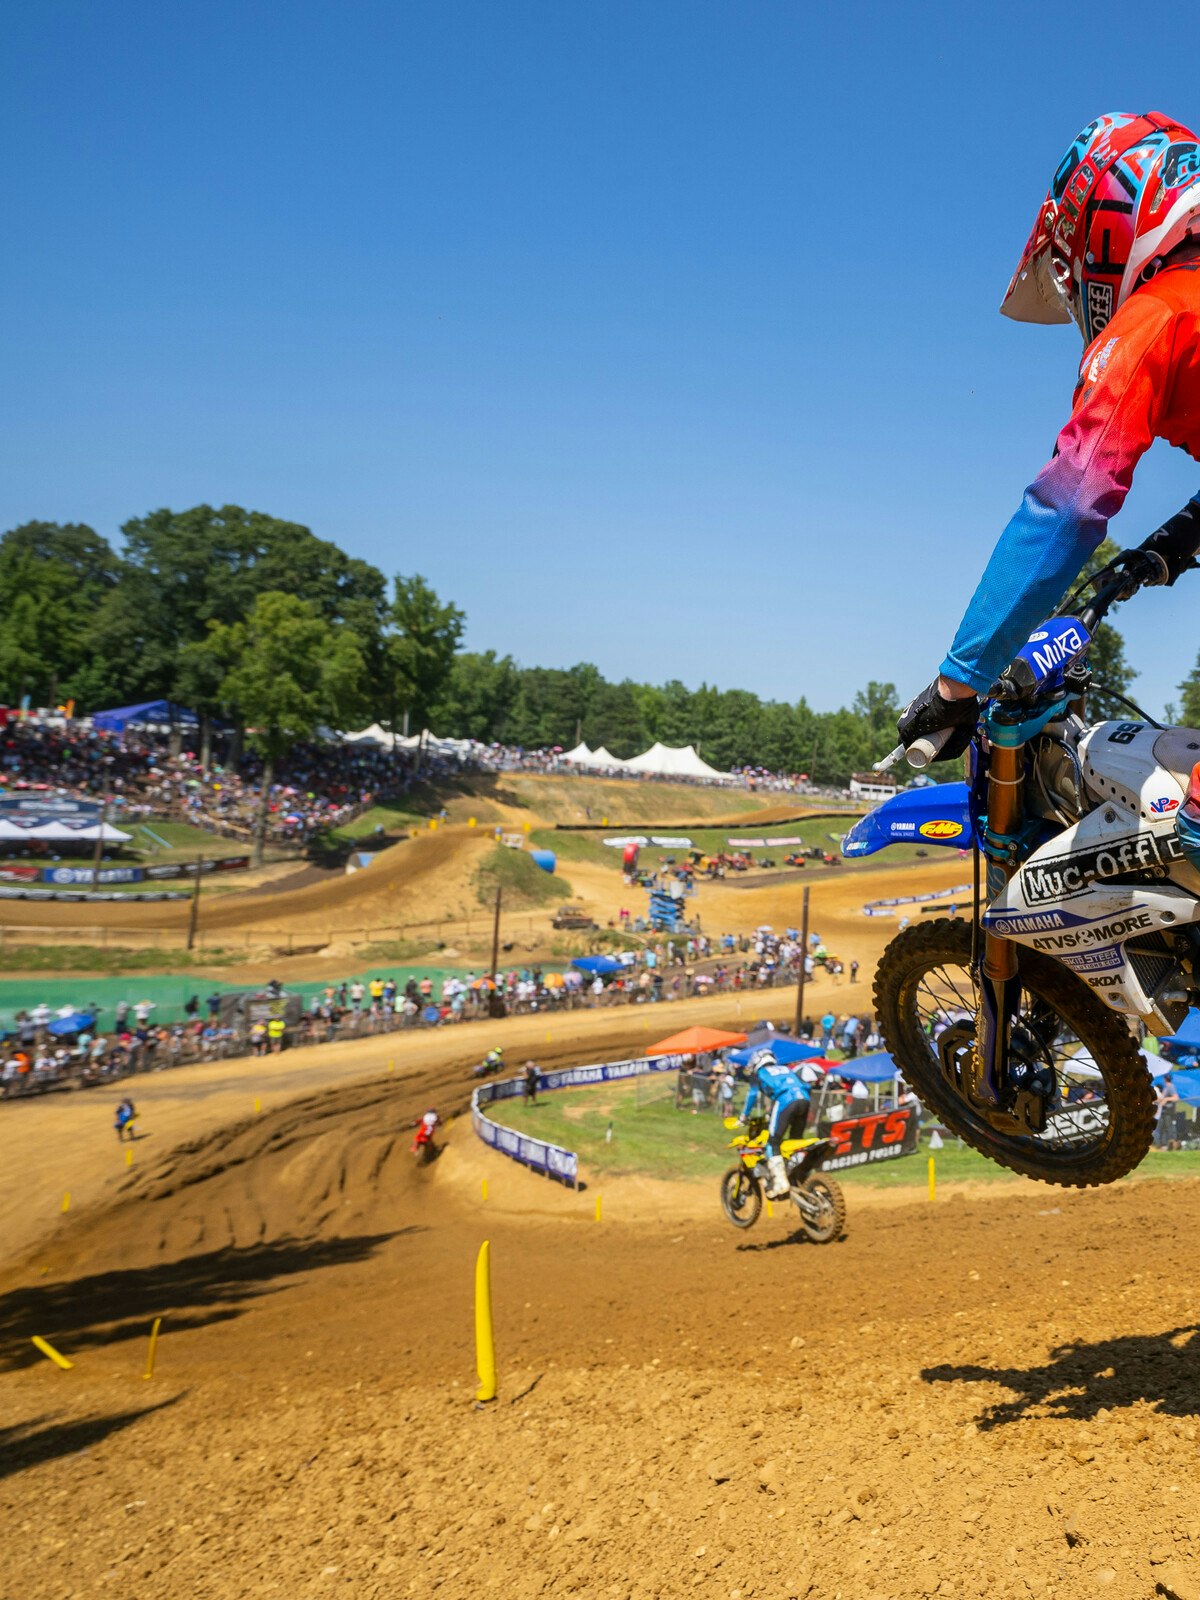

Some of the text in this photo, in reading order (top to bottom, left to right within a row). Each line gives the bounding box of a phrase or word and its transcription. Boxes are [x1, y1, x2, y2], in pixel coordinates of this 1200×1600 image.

[1032, 627, 1083, 678] Mika
[1107, 722, 1145, 745] 69
[1150, 797, 1170, 812] VP
[896, 822, 916, 831] YAMAHA
[920, 823, 962, 836] FMF
[1026, 840, 1152, 901] Muc-Off
[1009, 913, 1064, 932] YAMAHA
[1033, 912, 1153, 950] ATVS&MORE
[1061, 948, 1119, 966] SKID STEER
[831, 1108, 911, 1155] ETS
[822, 1143, 903, 1172] RACING FUELS
